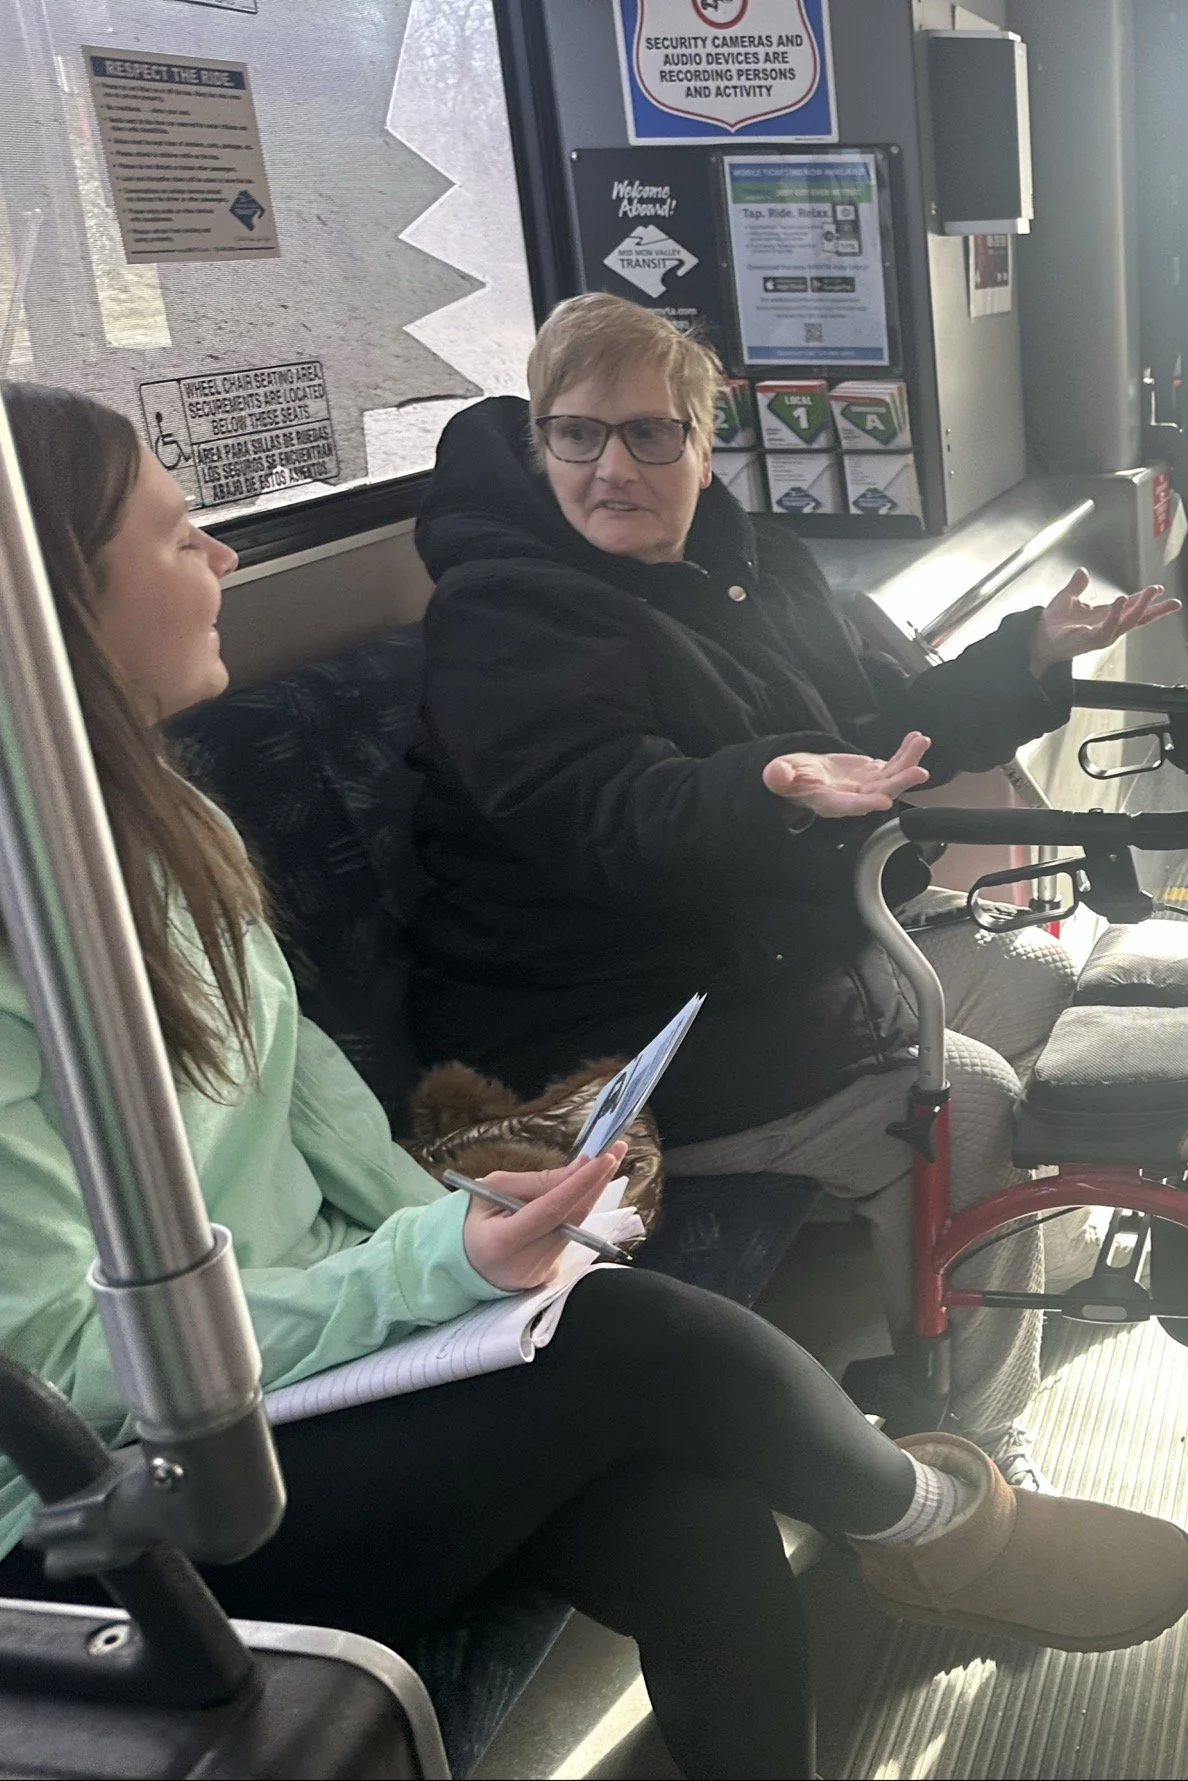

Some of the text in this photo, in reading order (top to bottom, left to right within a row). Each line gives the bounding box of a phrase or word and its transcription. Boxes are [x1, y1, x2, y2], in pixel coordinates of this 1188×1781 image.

[645, 34, 804, 50] SECURITY CAMERAS AND
[663, 51, 789, 66] AUDIO DEVICES ARE
[104, 60, 169, 81] RESPECT
[171, 67, 200, 83] THE
[659, 68, 796, 82] RECORDING PERSONS
[685, 85, 773, 98] AND ACTIVITY
[612, 180, 677, 218] Welcome Aboard!
[742, 208, 765, 220] Tap.
[767, 208, 795, 218] Ride.
[655, 249, 680, 257] VALLEY
[619, 258, 666, 269] TRANSIT
[183, 379, 222, 399] WHEEL
[223, 374, 251, 394] CHAIR
[255, 369, 294, 389] SEATING
[188, 383, 325, 419] SECUREMENTS ARE LOCATED
[784, 396, 812, 405] LOCAL
[212, 416, 248, 436] BELOW
[250, 411, 278, 429] THESE
[792, 407, 809, 429] 1
[865, 414, 885, 431] A
[225, 440, 249, 460] PARA
[284, 431, 295, 447] DE
[203, 444, 333, 483] LOS SEGUROS SE ENCUENTRAN
[212, 481, 243, 501] ABAJO
[245, 476, 258, 493] DE
[260, 469, 287, 491] ESTOS
